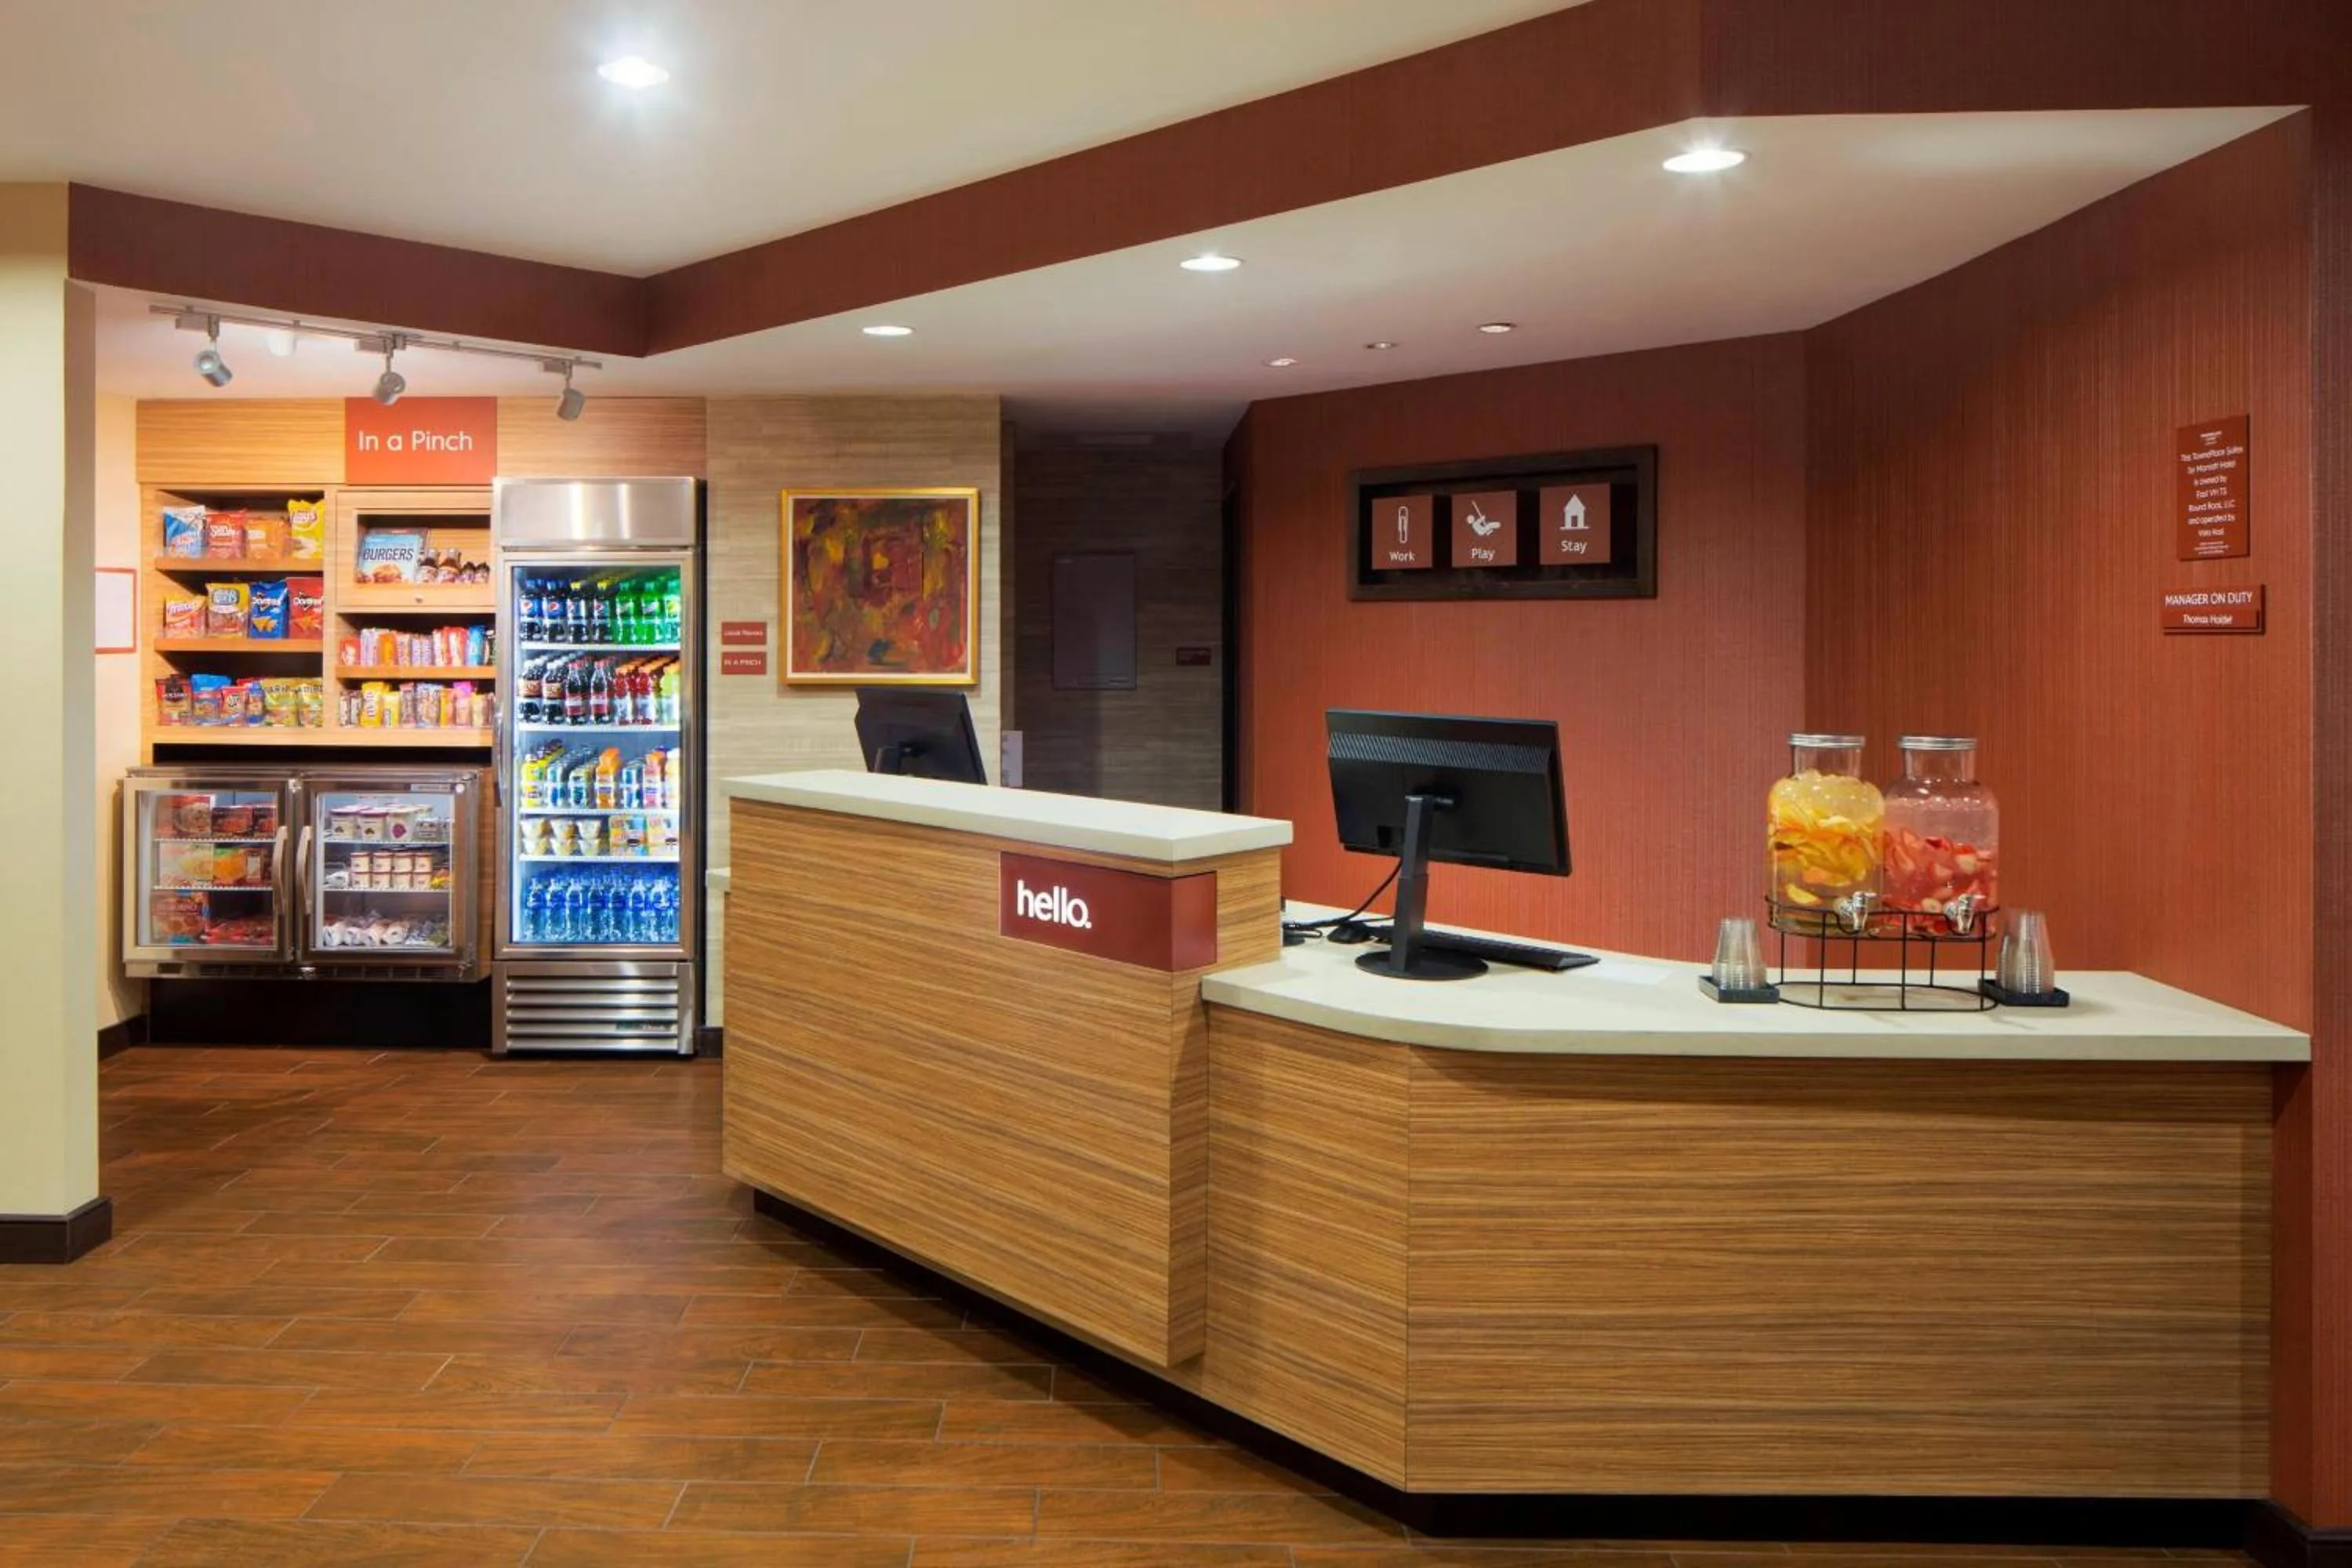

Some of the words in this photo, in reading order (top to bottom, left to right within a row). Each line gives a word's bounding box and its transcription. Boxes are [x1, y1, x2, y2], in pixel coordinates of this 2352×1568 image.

[358, 430, 379, 452] In
[387, 435, 402, 452] a
[412, 430, 473, 452] Pinch
[1561, 540, 1587, 554] Stay
[362, 548, 414, 561] BURGERS
[1389, 550, 1415, 562] Work
[1471, 548, 1496, 561] Play
[2165, 593, 2209, 607] MANAGER
[2211, 592, 2225, 604] ON
[2227, 591, 2252, 604] DUTY
[1017, 879, 1092, 929] hello.
